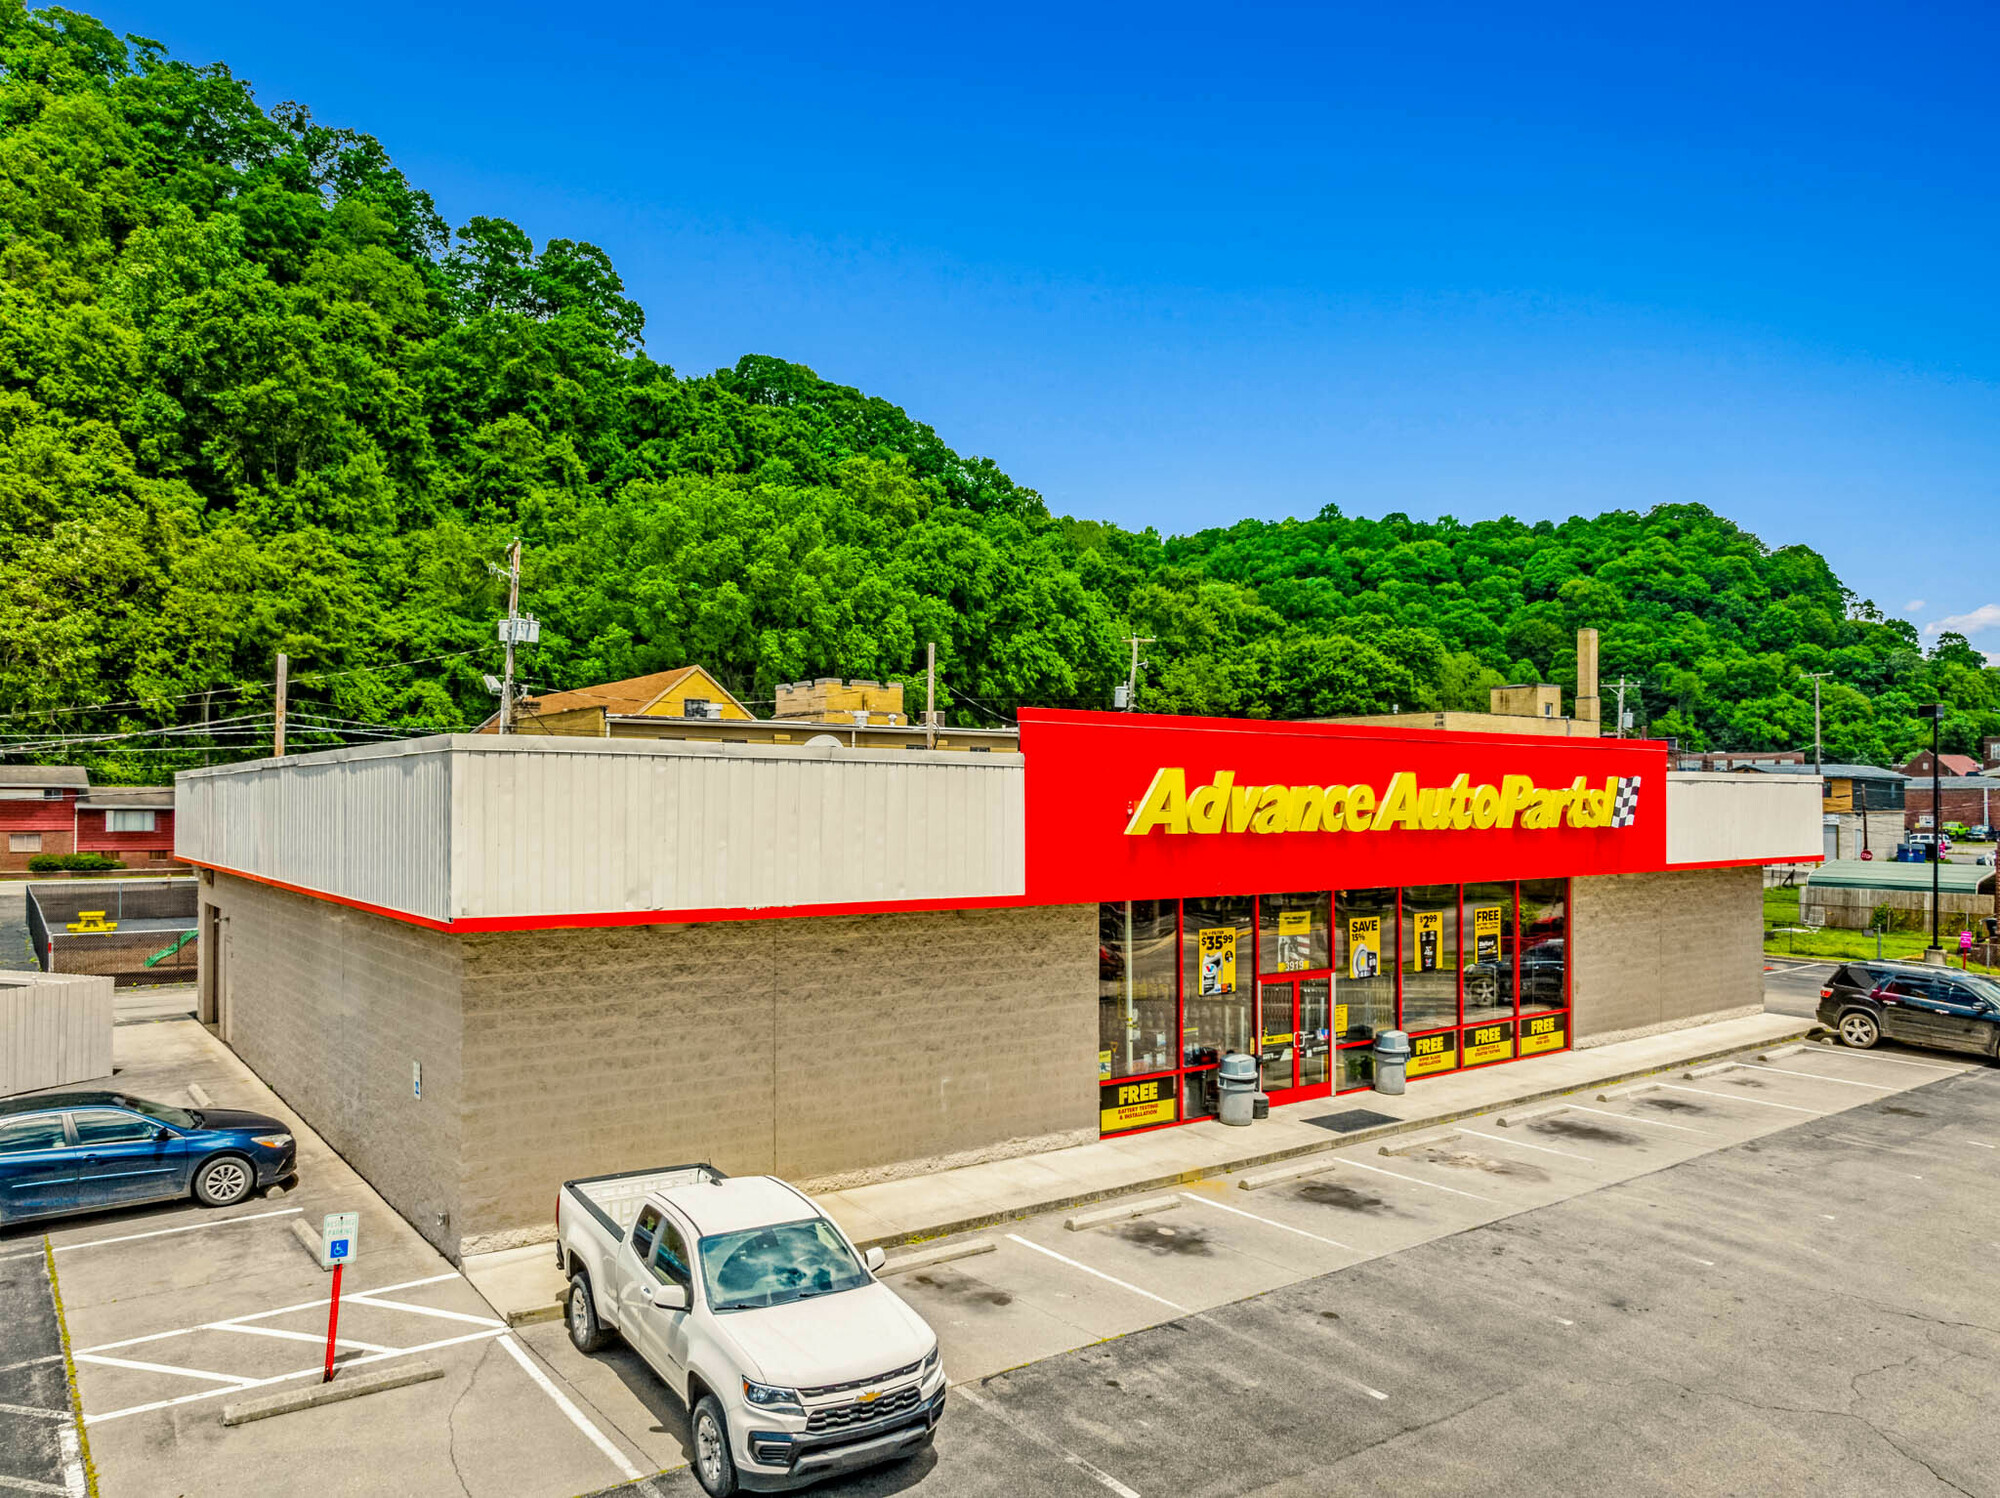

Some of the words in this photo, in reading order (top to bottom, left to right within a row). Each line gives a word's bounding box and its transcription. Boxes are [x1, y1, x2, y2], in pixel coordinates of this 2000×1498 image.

[1124, 767, 1375, 834] Advance
[1477, 910, 1499, 922] FREE
[1352, 920, 1377, 932] SAVE
[1352, 932, 1365, 941] 15%
[1285, 961, 1304, 970] 3919
[1531, 1017, 1554, 1035] FREE
[1475, 1027, 1500, 1045] FREE
[1416, 1036, 1443, 1055] FREE
[1119, 1082, 1158, 1105] FREE
[1118, 1106, 1138, 1114] BATTERY
[1124, 1110, 1157, 1119] INSTALLATION
